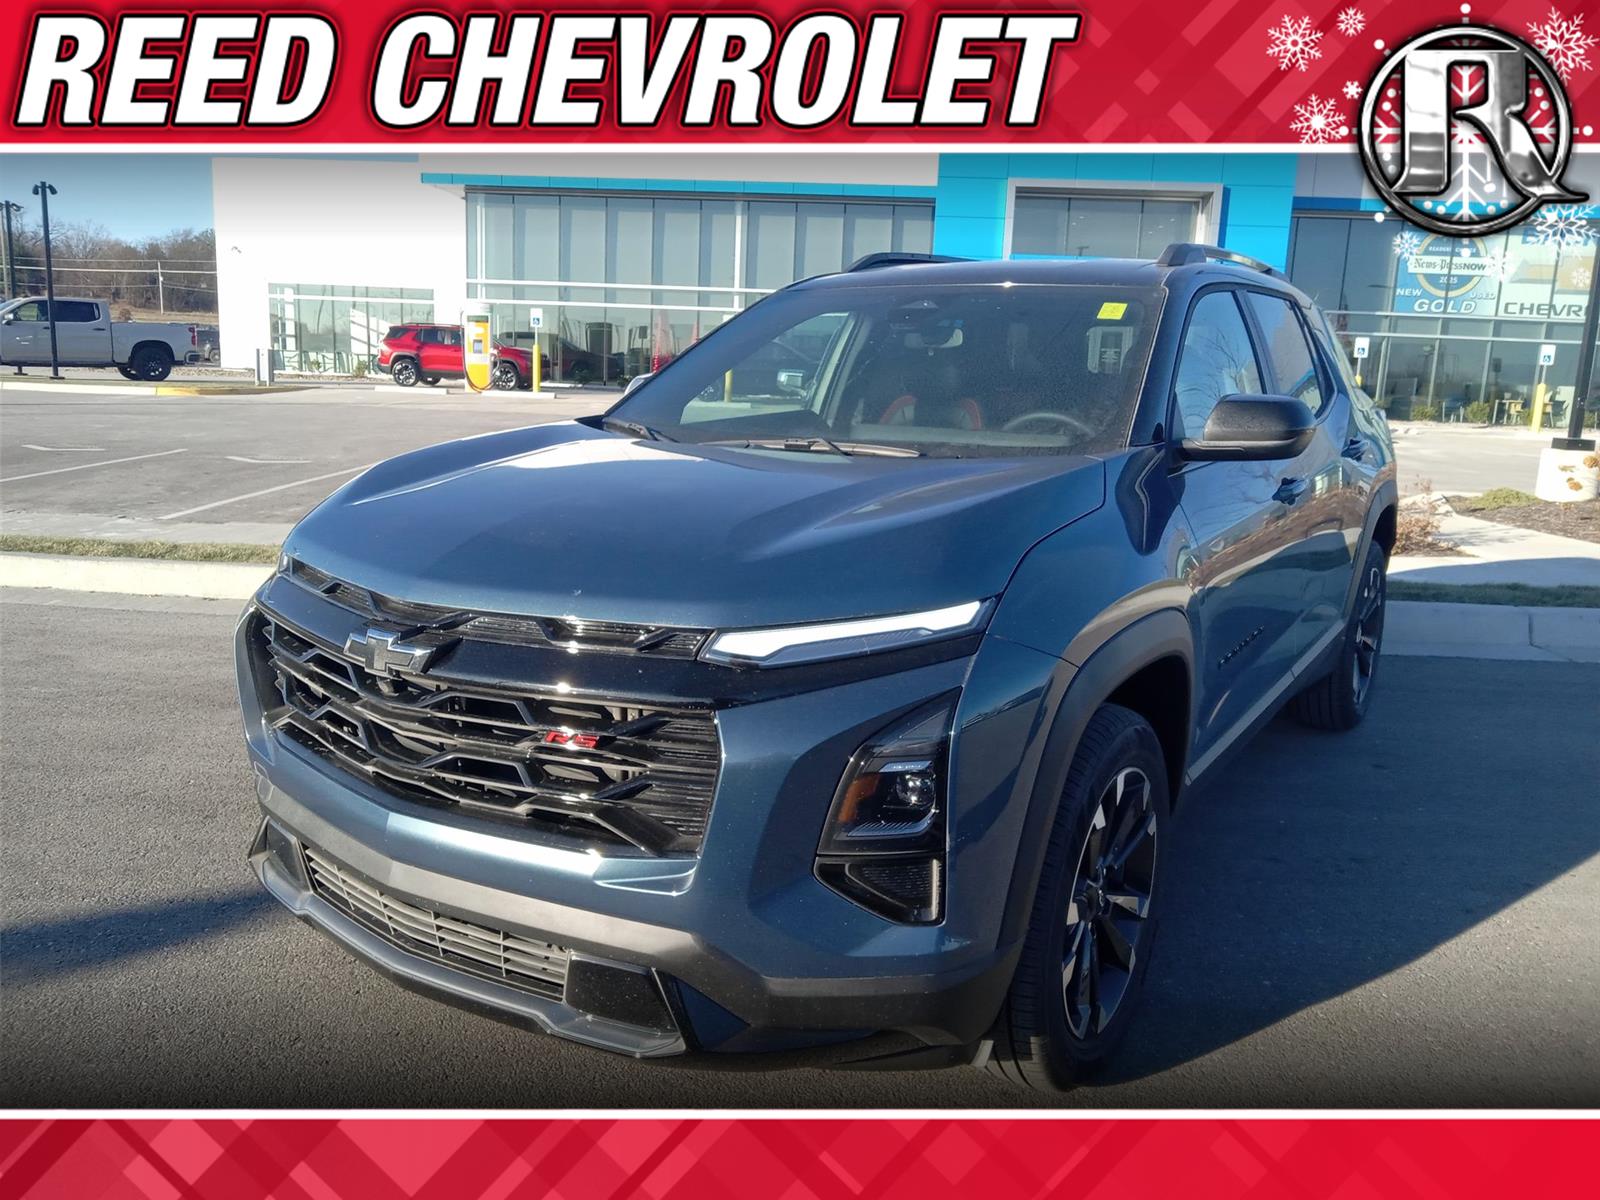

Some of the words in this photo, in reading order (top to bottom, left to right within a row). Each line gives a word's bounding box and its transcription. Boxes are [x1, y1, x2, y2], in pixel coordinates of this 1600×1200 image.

[1395, 287, 1423, 297] NEW
[1470, 291, 1496, 300] USED
[1413, 299, 1476, 314] GOLD
[1503, 302, 1587, 317] CHEVR
[544, 730, 600, 749] RS
